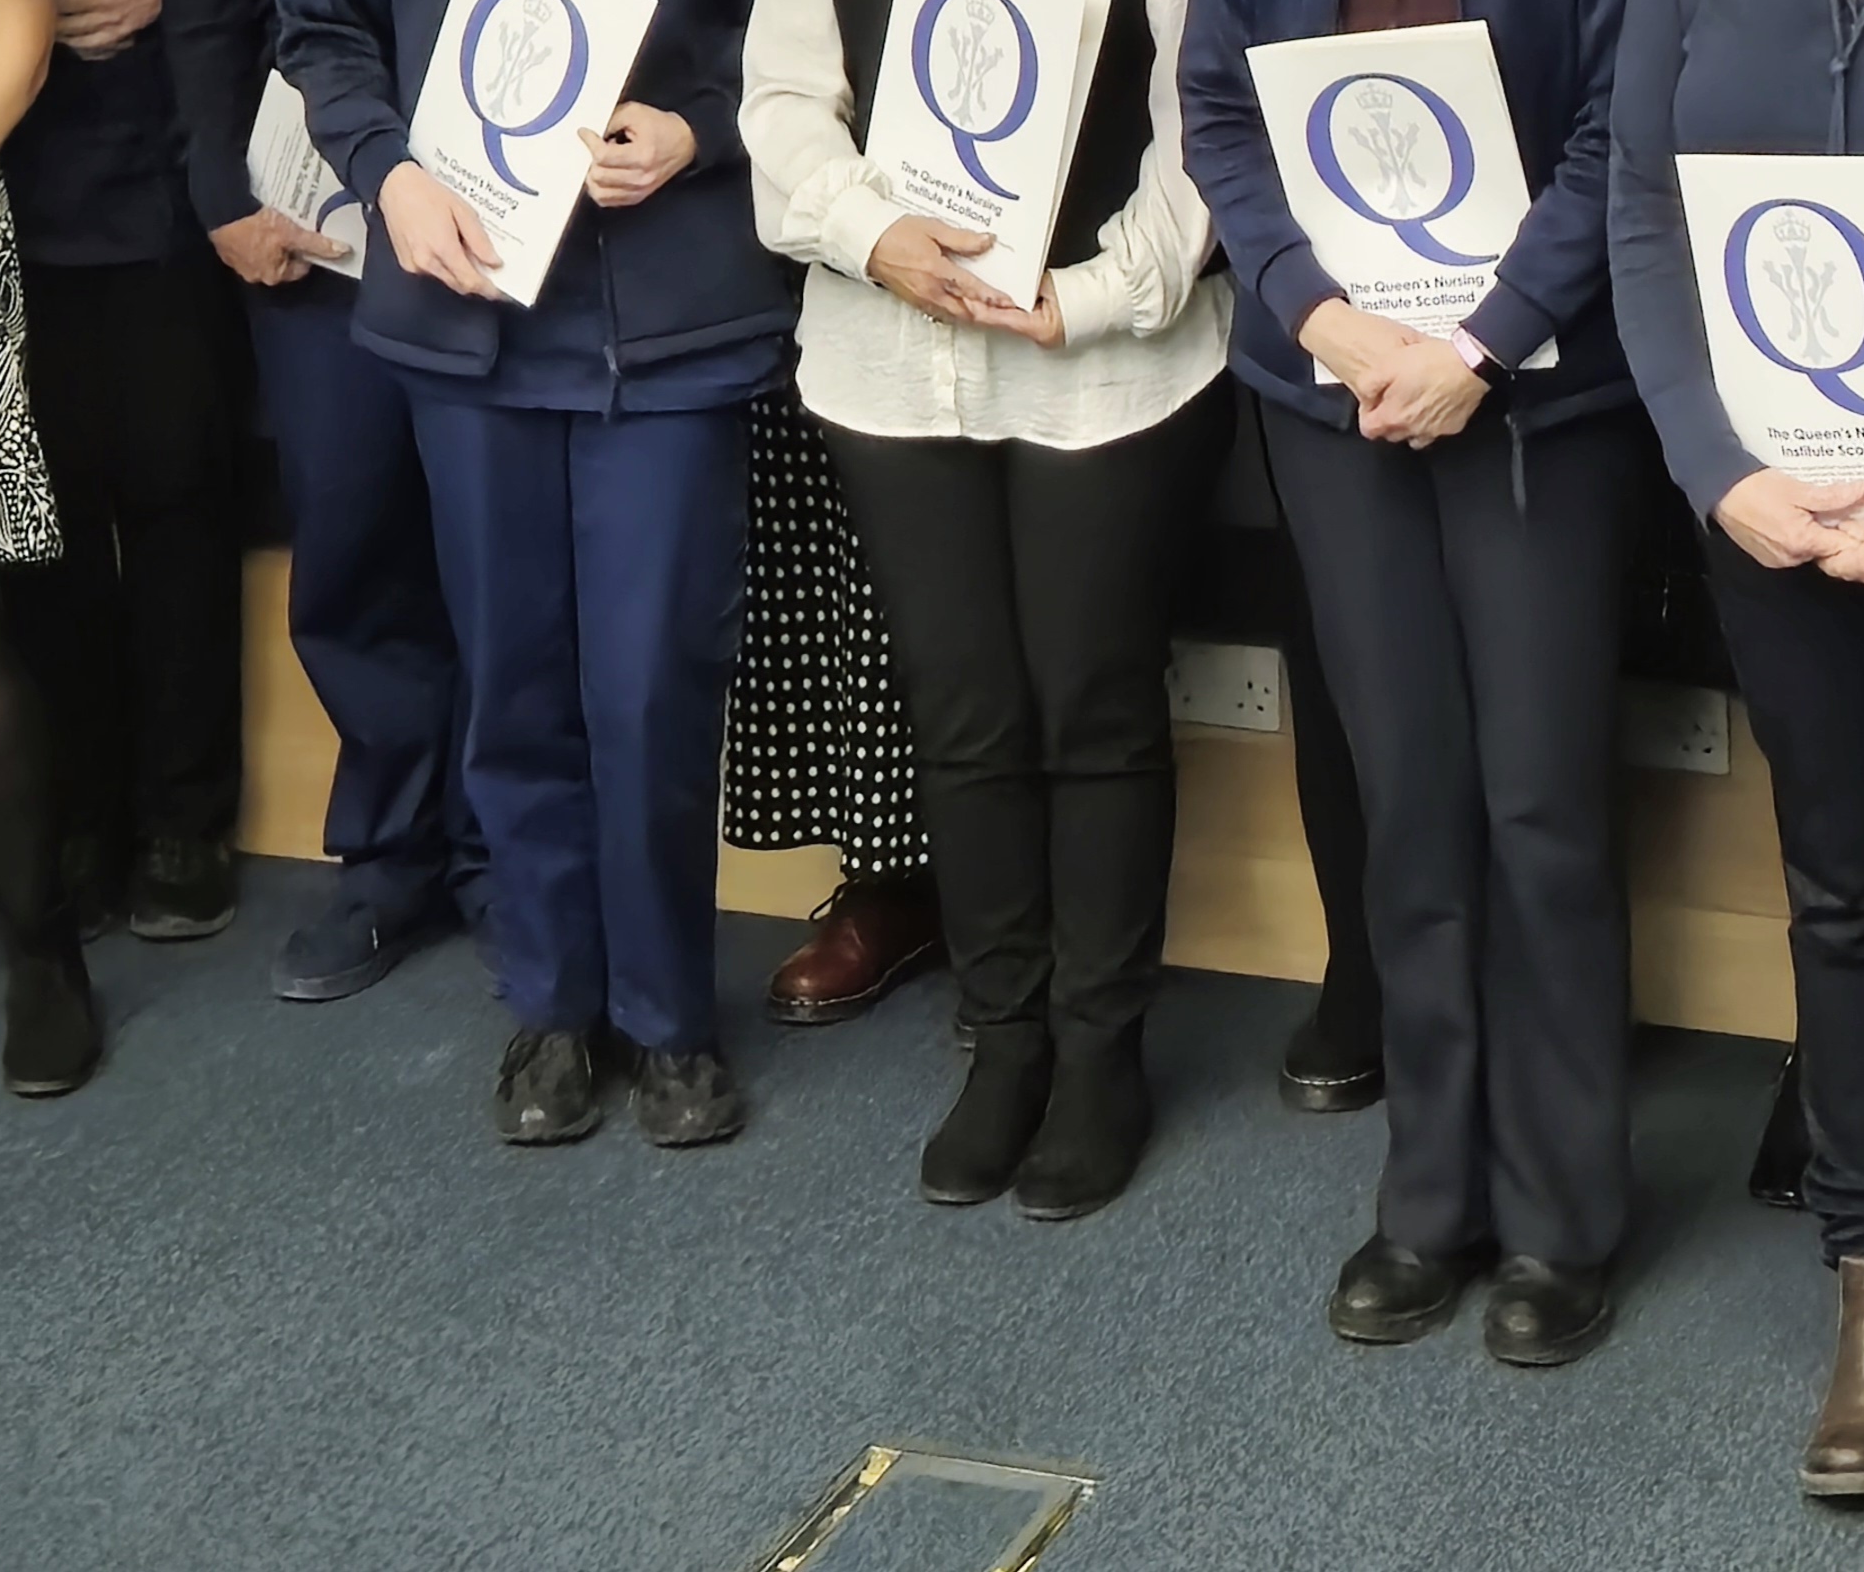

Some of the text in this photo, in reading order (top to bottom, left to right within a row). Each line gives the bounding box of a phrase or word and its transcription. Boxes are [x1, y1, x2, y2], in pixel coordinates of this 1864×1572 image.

[1306, 73, 1499, 266] Q
[901, 160, 918, 177] The
[920, 170, 962, 197] Queen's
[965, 190, 1003, 217] Nursing
[905, 179, 943, 206] Institute
[945, 198, 991, 227] Scotland
[1350, 274, 1484, 294] The Queen's Nursing
[1361, 291, 1475, 310] Institute Scotland
[1767, 427, 1790, 440] The
[1793, 427, 1852, 441] Queen's
[1781, 445, 1834, 457] Institute
